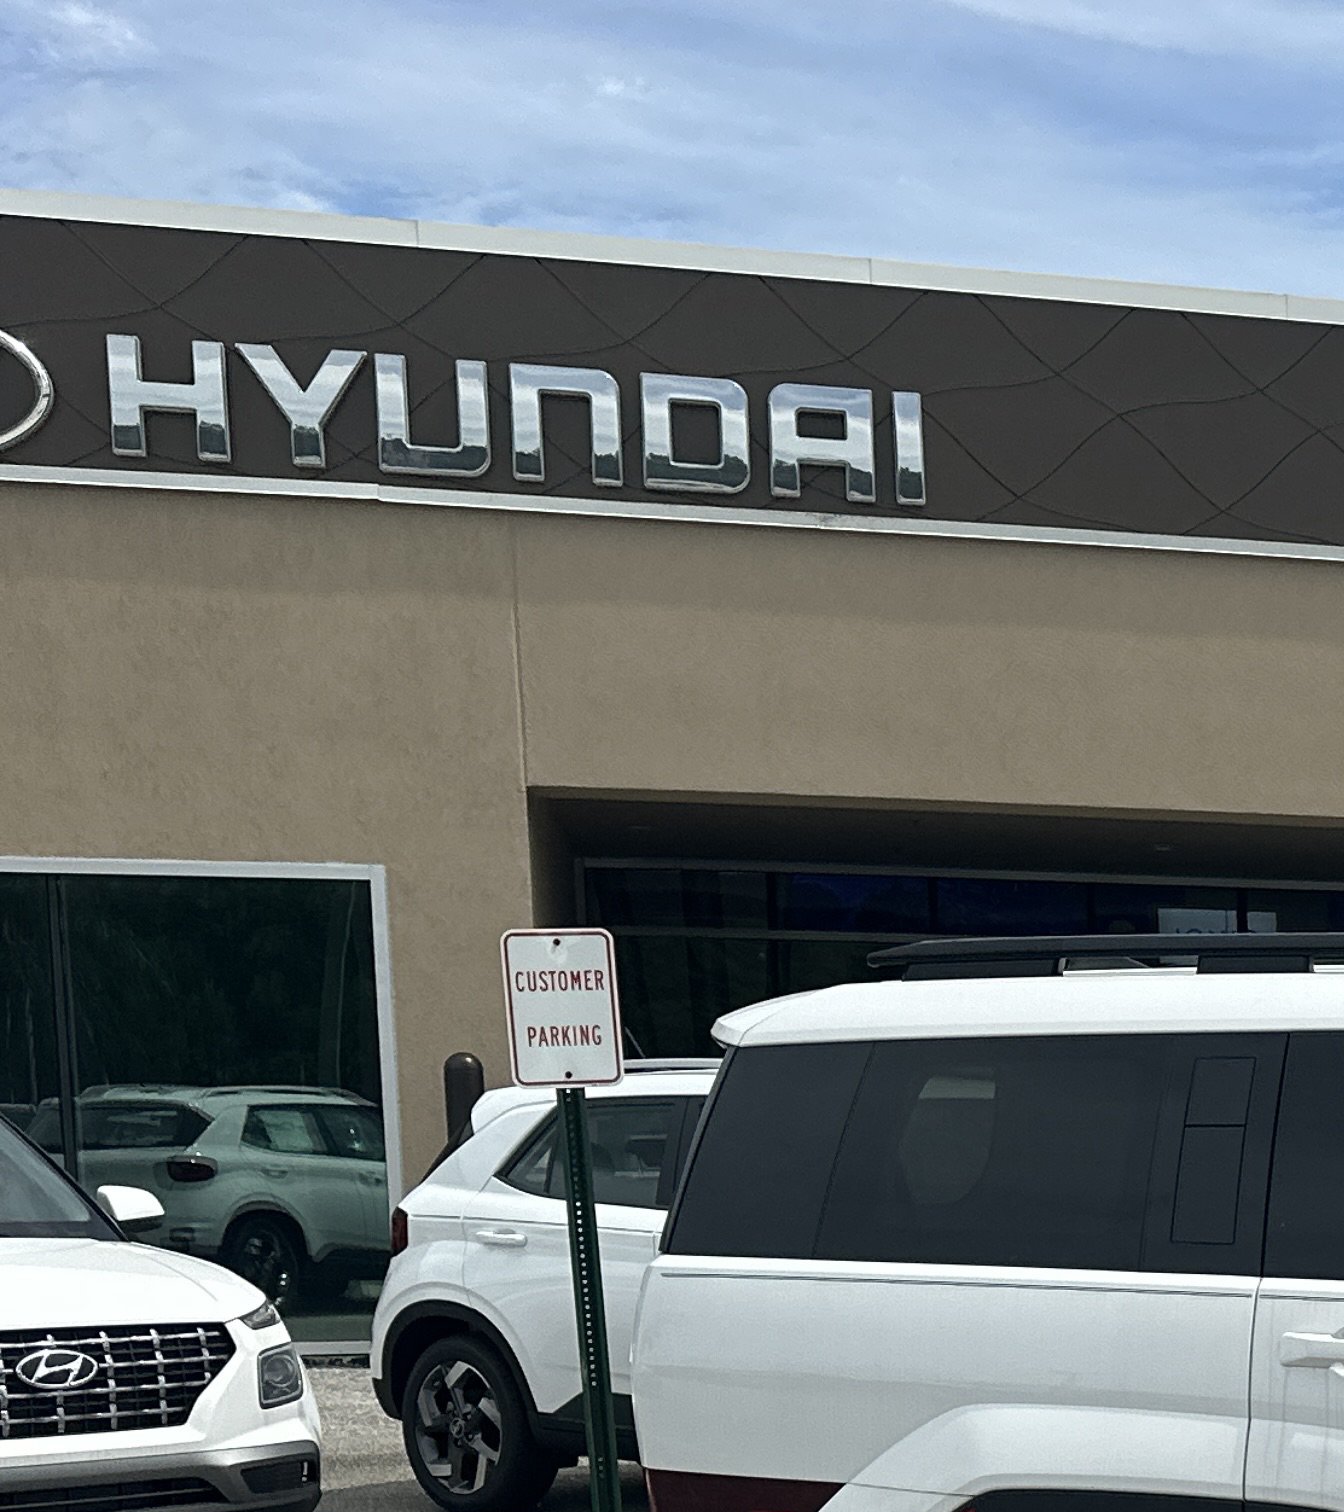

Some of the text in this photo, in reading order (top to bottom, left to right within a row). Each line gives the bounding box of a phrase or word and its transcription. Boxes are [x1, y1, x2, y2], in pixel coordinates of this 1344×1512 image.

[104, 333, 926, 507] HYUNDAI
[515, 969, 605, 992] CUSTOMER
[527, 1024, 602, 1048] PARKING
